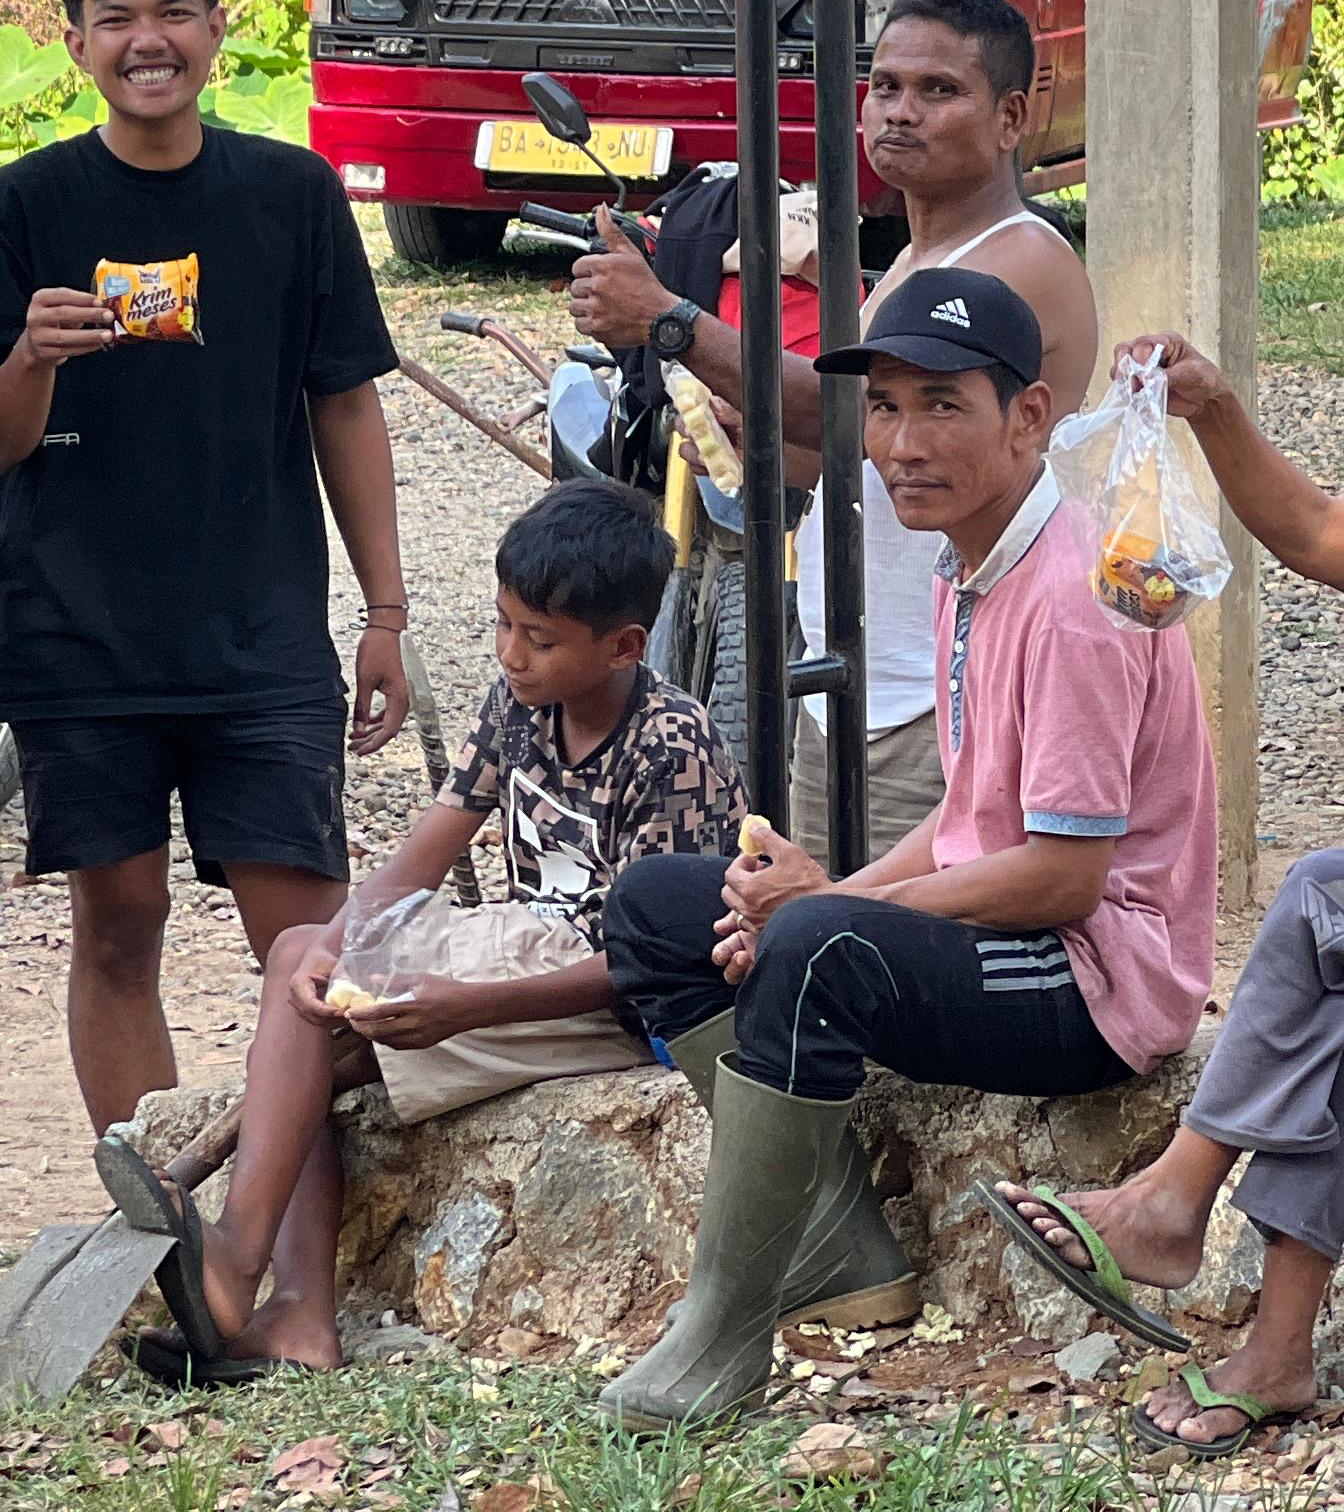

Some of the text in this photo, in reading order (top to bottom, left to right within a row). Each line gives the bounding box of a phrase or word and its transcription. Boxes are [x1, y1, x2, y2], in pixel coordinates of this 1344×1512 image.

[498, 125, 528, 155] BA
[617, 129, 647, 159] NU
[126, 296, 177, 322] meses
[130, 286, 172, 309] Krim
[930, 310, 971, 328] adidas
